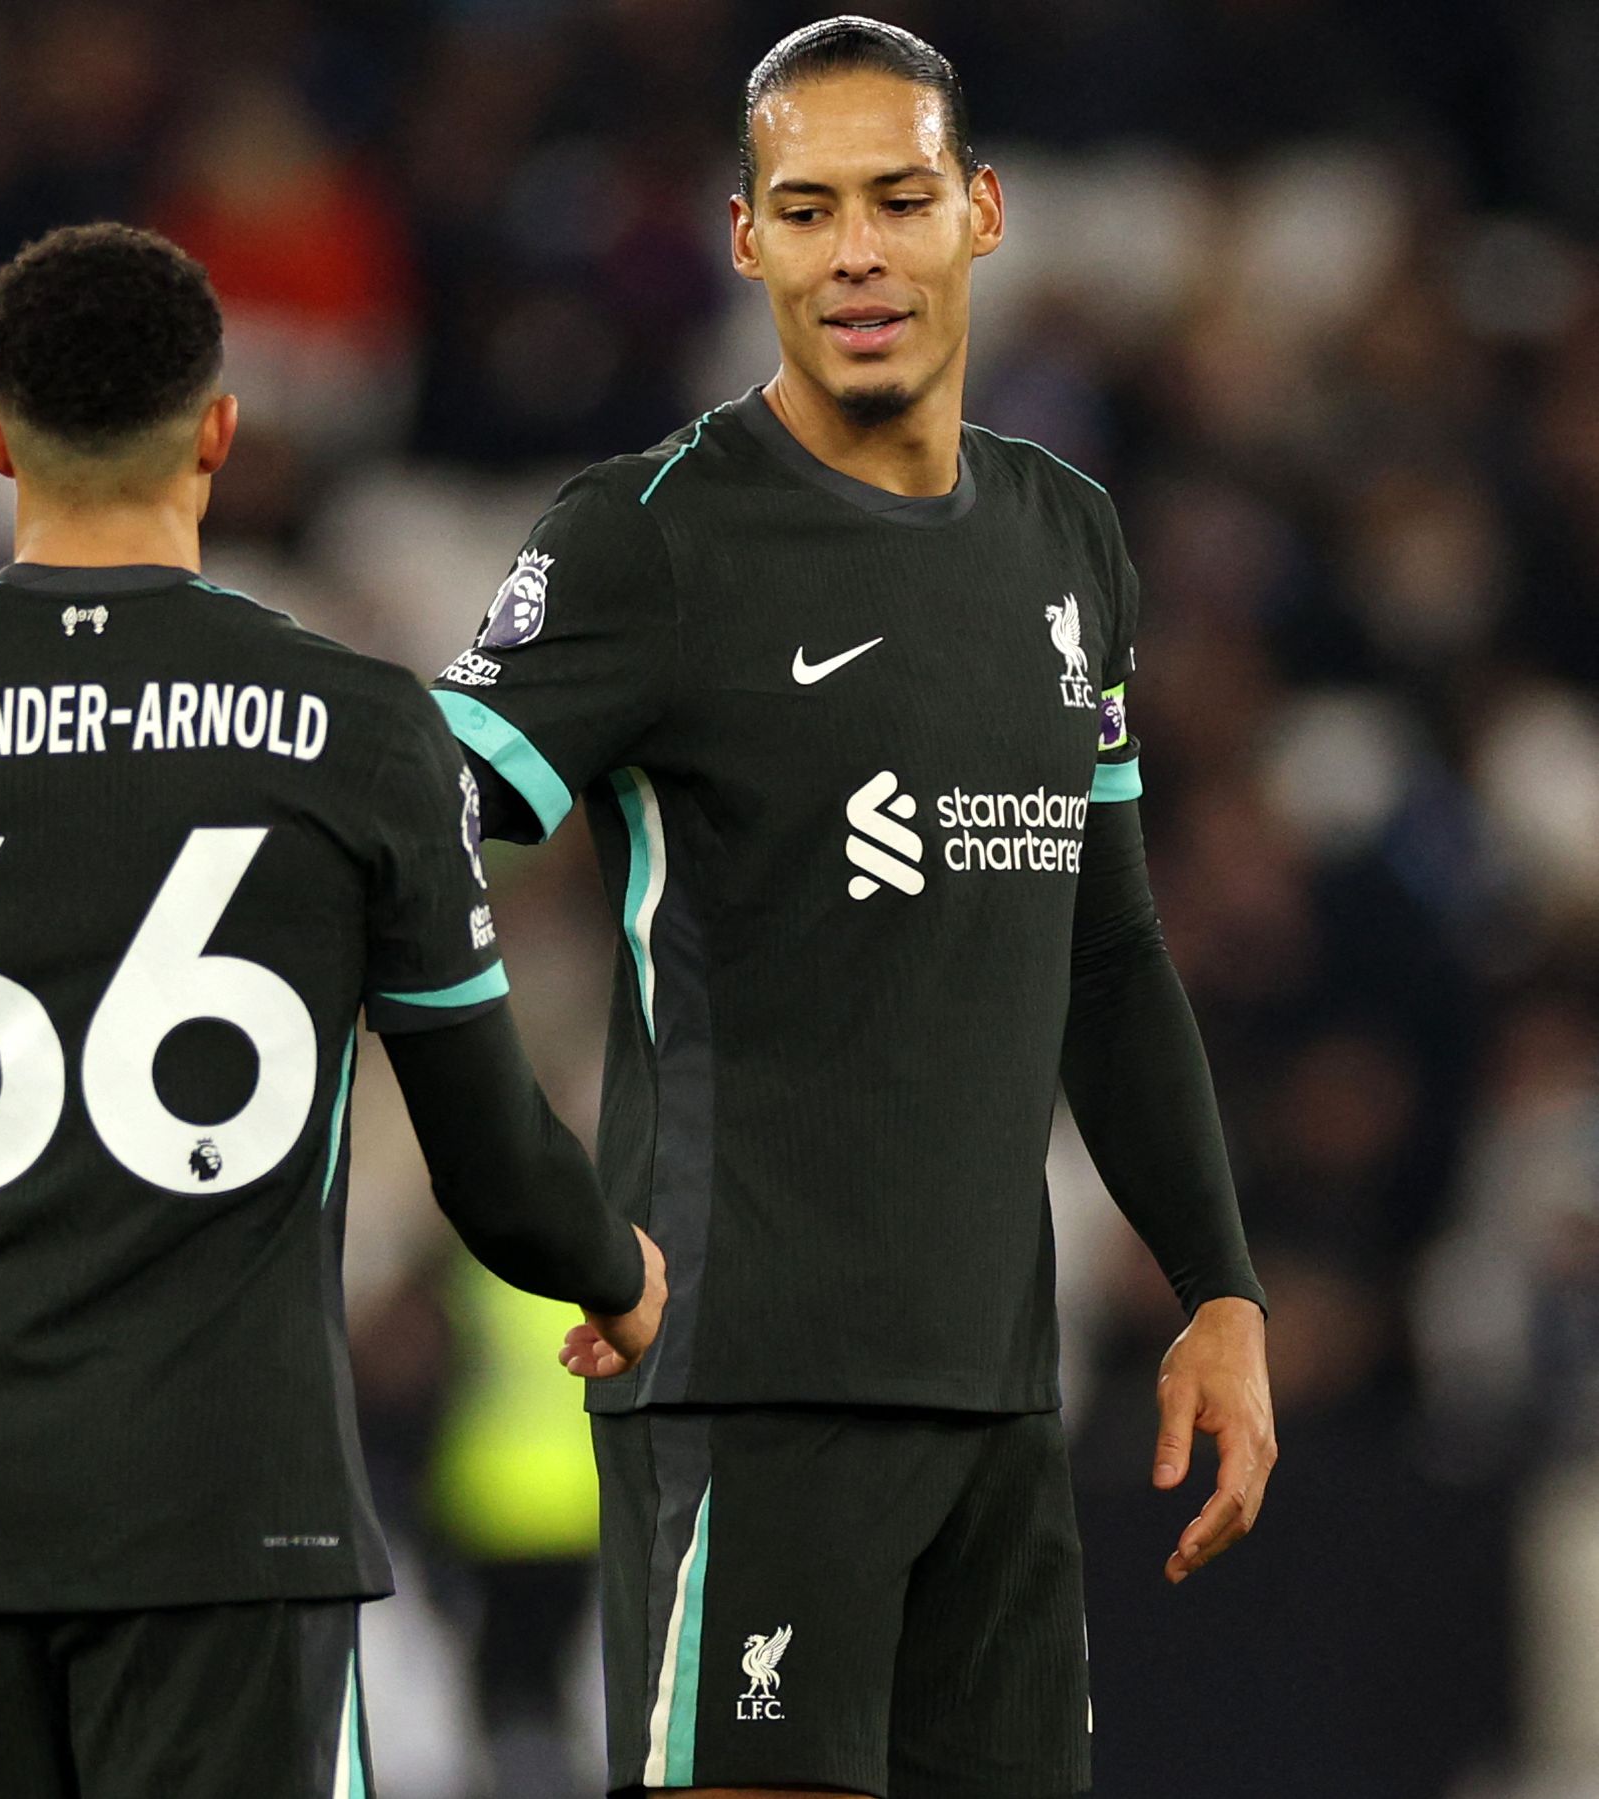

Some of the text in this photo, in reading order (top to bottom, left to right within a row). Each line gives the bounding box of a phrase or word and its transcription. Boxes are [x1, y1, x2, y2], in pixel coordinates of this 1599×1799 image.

[454, 648, 502, 678] oom
[936, 785, 1089, 831] standard
[736, 1700, 786, 1720] L.F.C.
